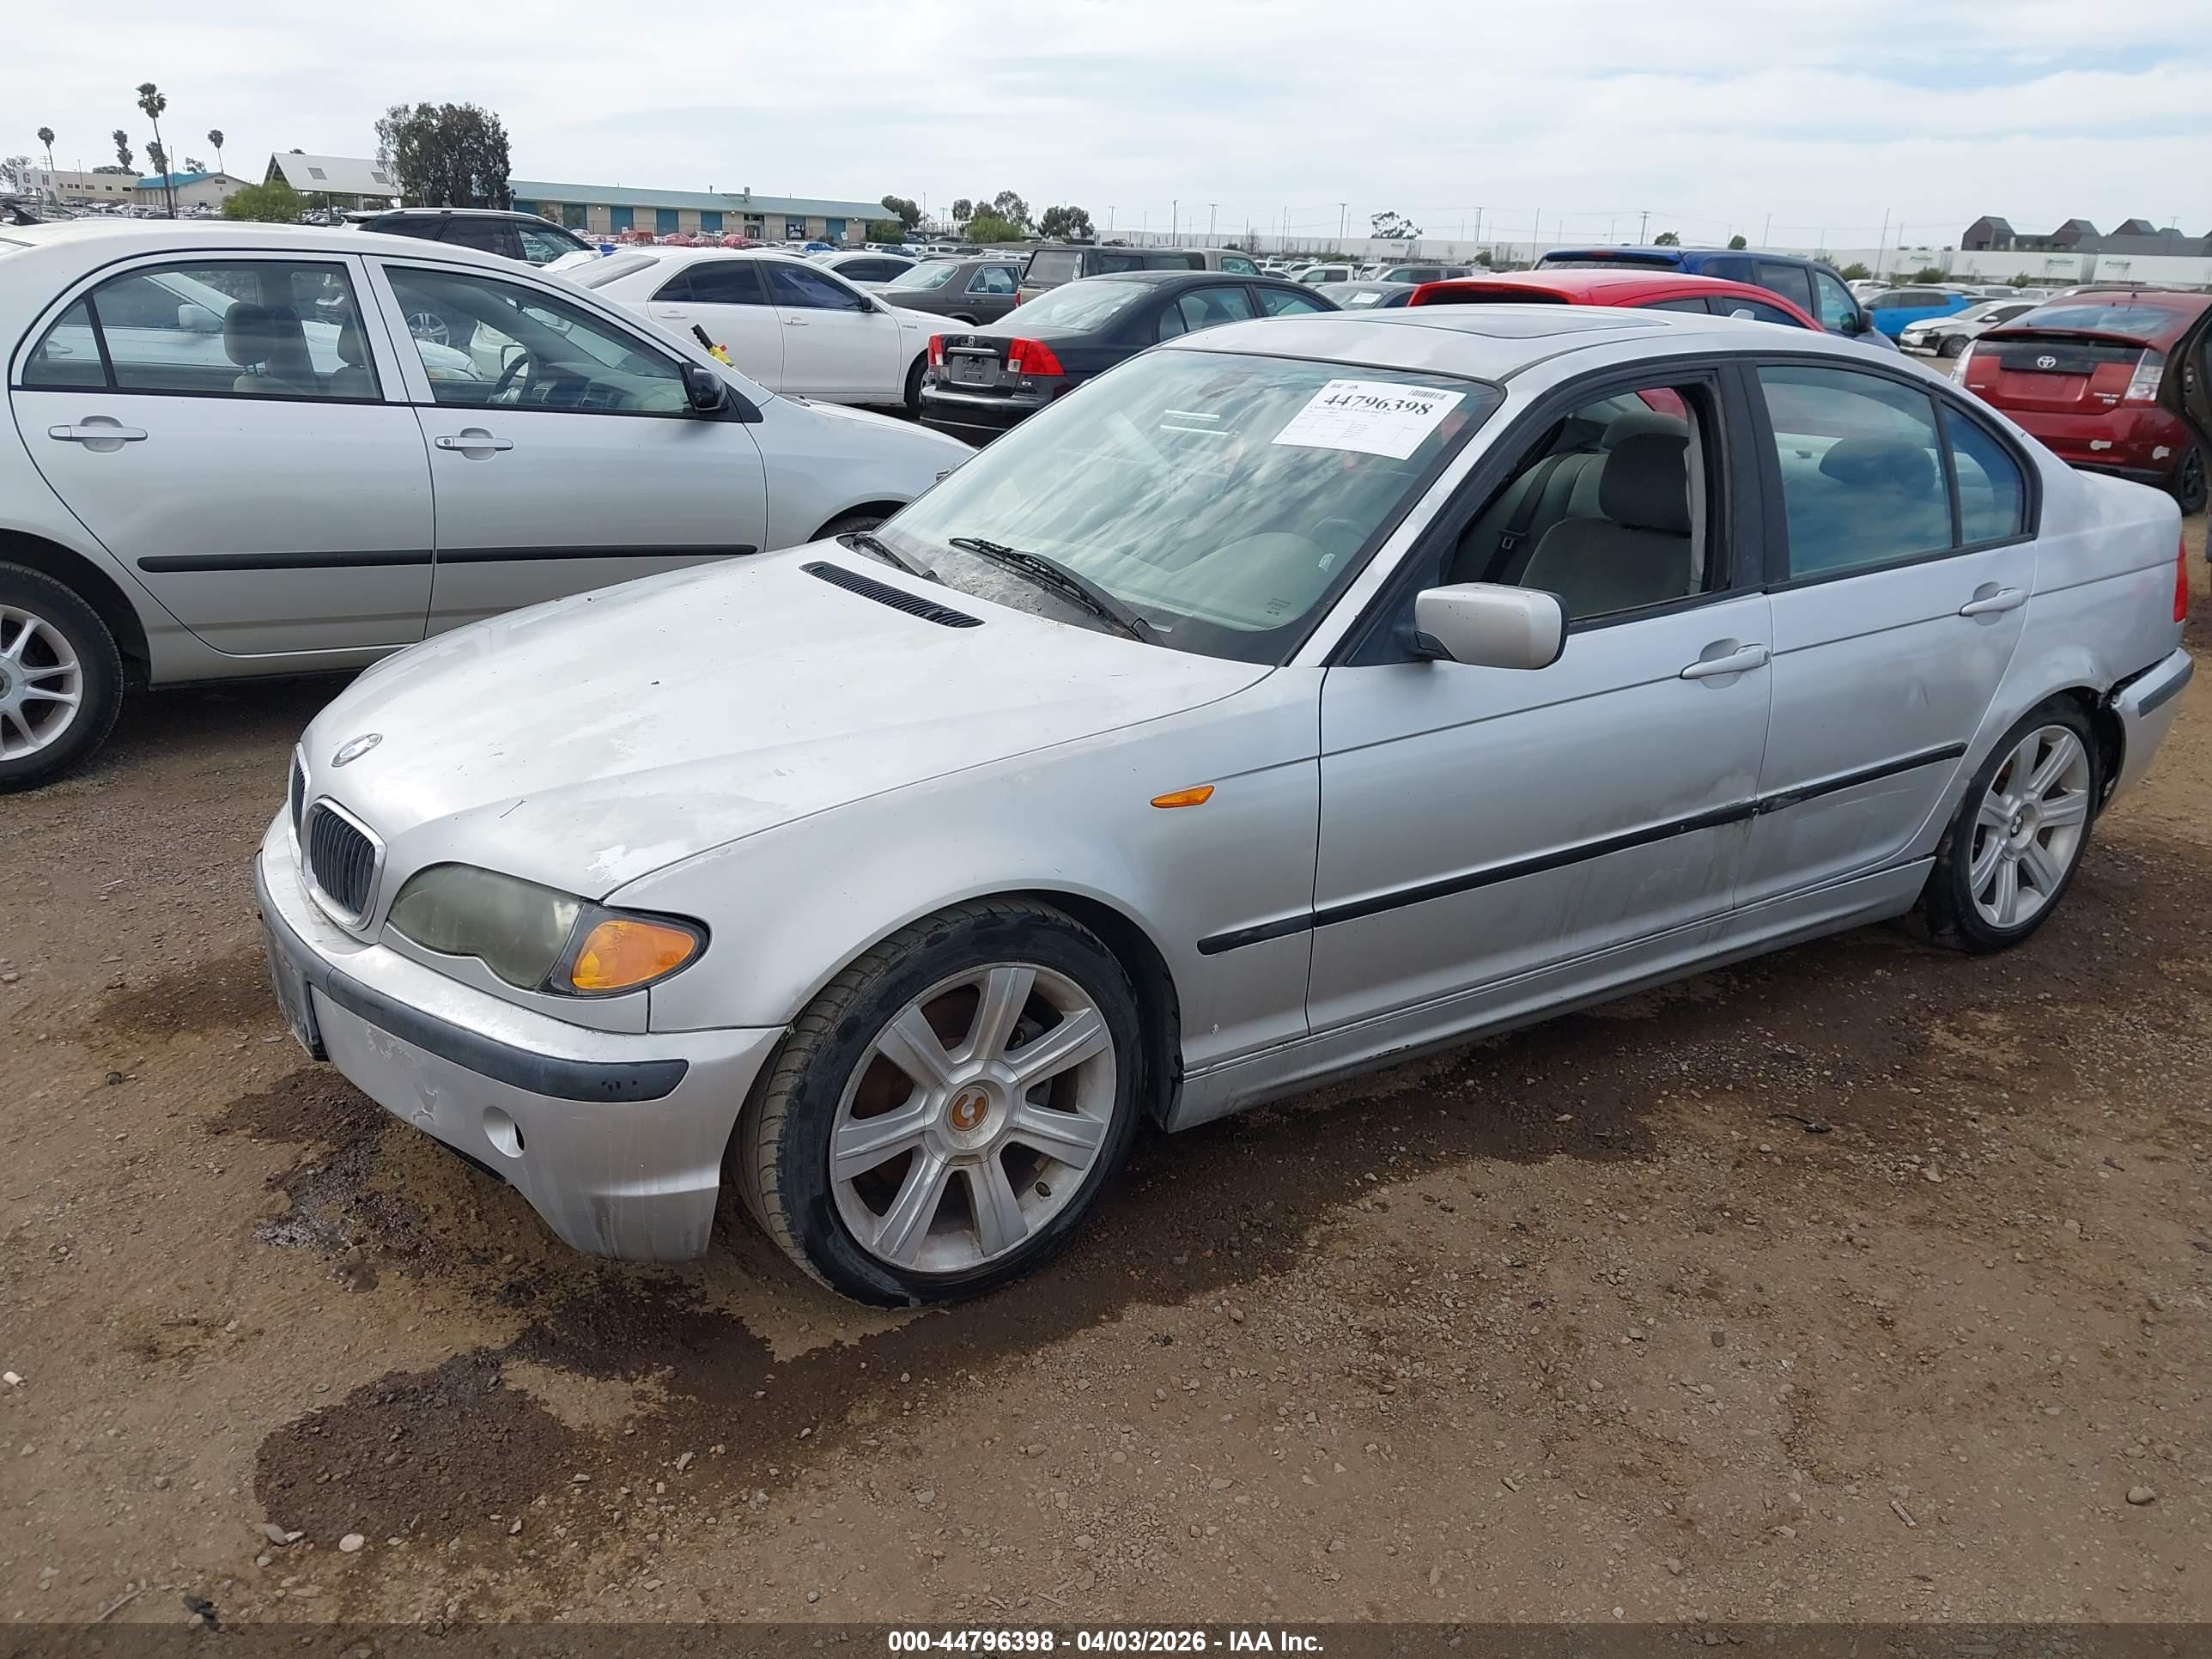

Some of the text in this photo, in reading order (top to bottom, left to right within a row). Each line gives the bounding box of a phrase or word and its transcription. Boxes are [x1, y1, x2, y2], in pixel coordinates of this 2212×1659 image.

[22, 172, 31, 184] G
[41, 173, 50, 186] H
[1323, 393, 1435, 416] 44796398
